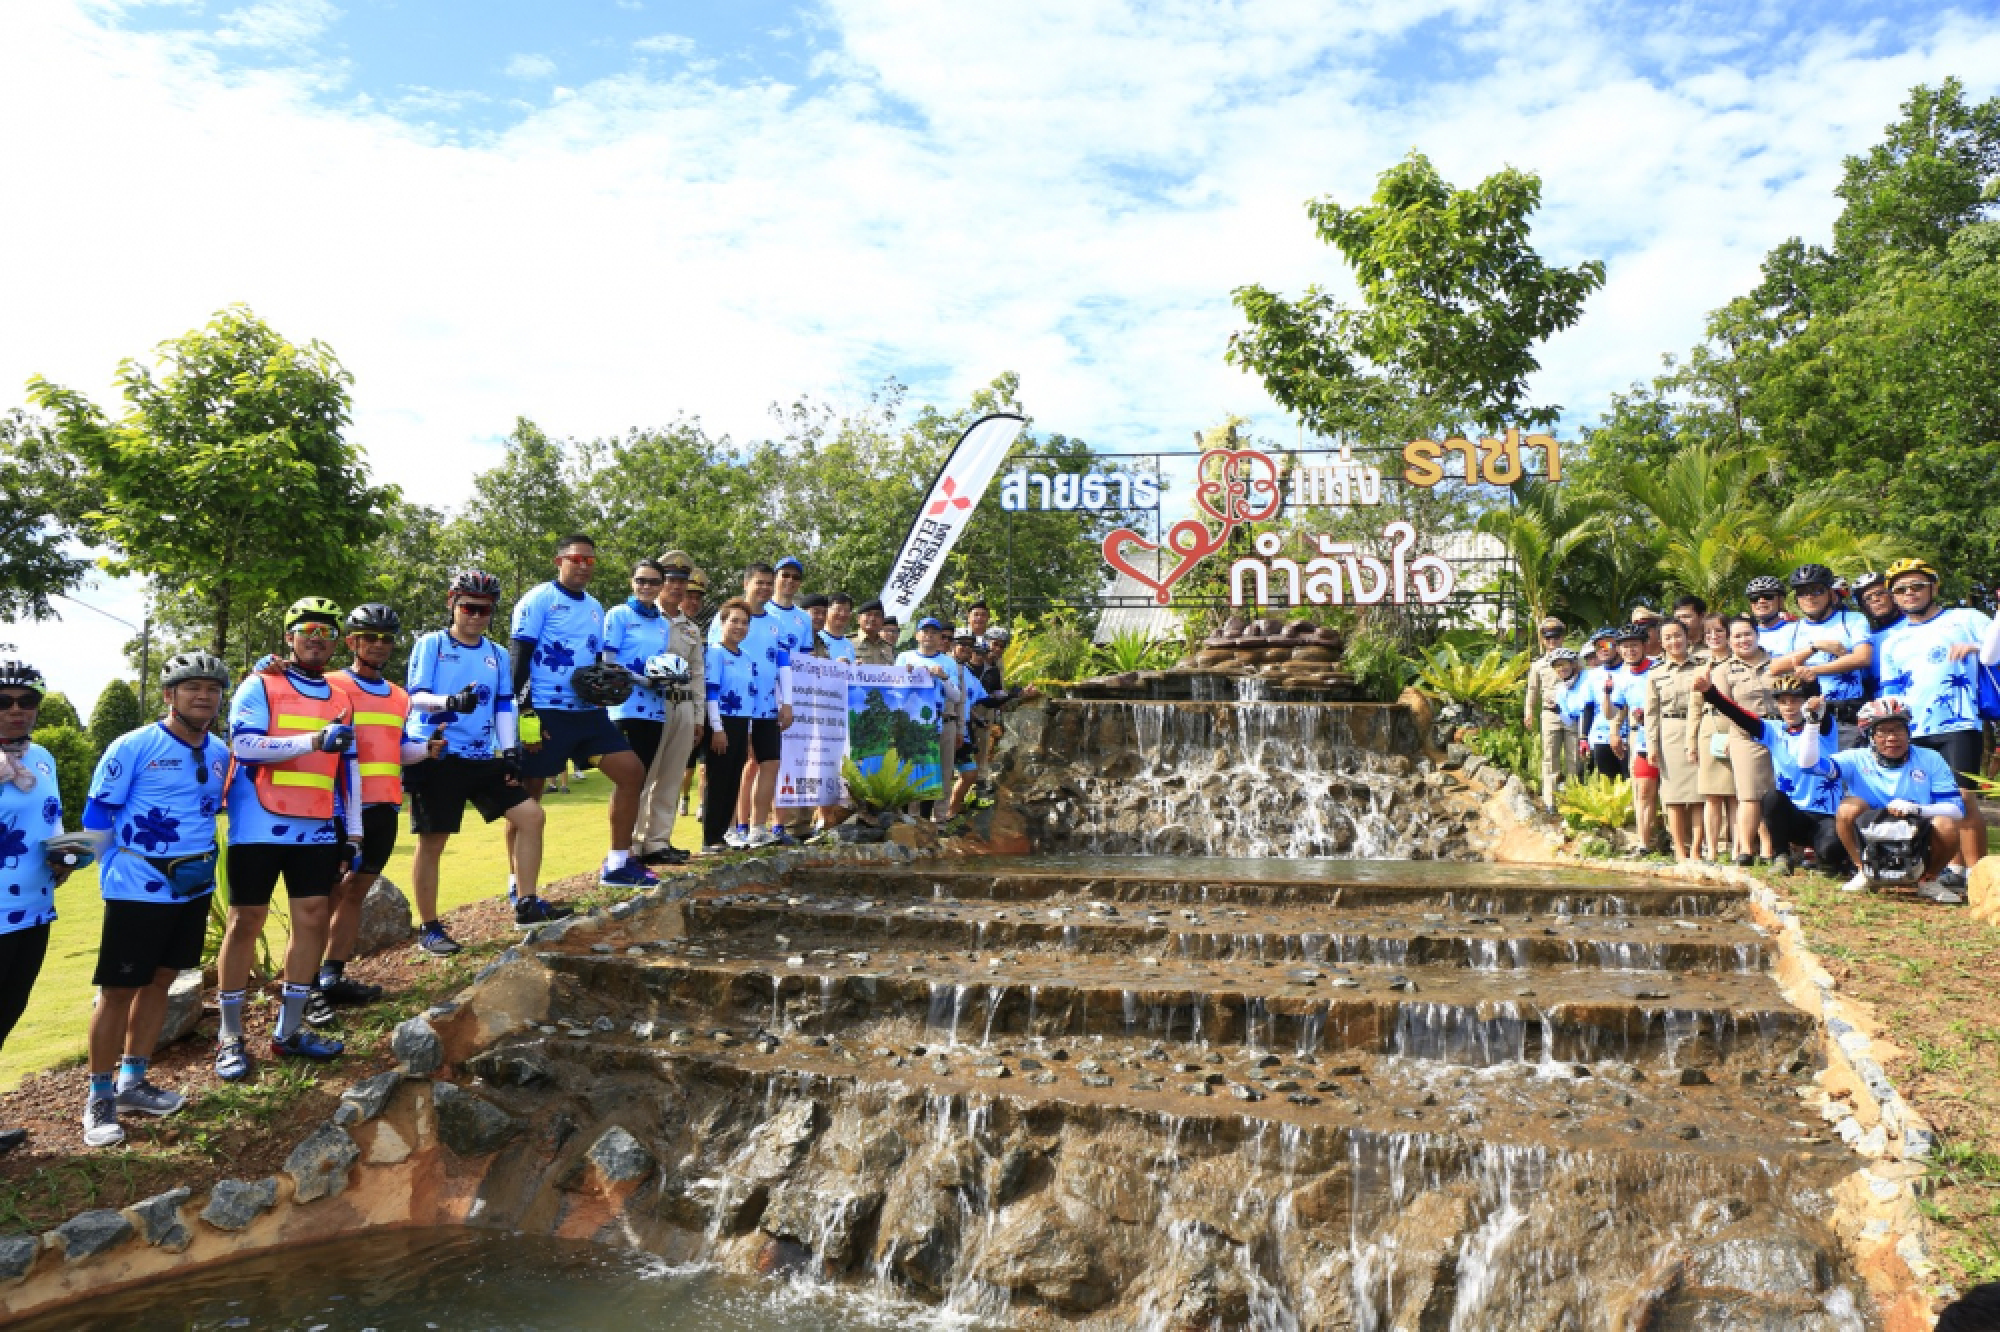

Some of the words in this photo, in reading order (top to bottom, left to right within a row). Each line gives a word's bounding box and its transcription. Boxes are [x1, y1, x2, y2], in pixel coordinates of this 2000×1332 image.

[1001, 467, 1159, 511] สายธาร
[1293, 446, 1381, 505] แห่ง
[1403, 428, 1561, 488] ราชา
[1230, 521, 1454, 606] กำลังใจ
